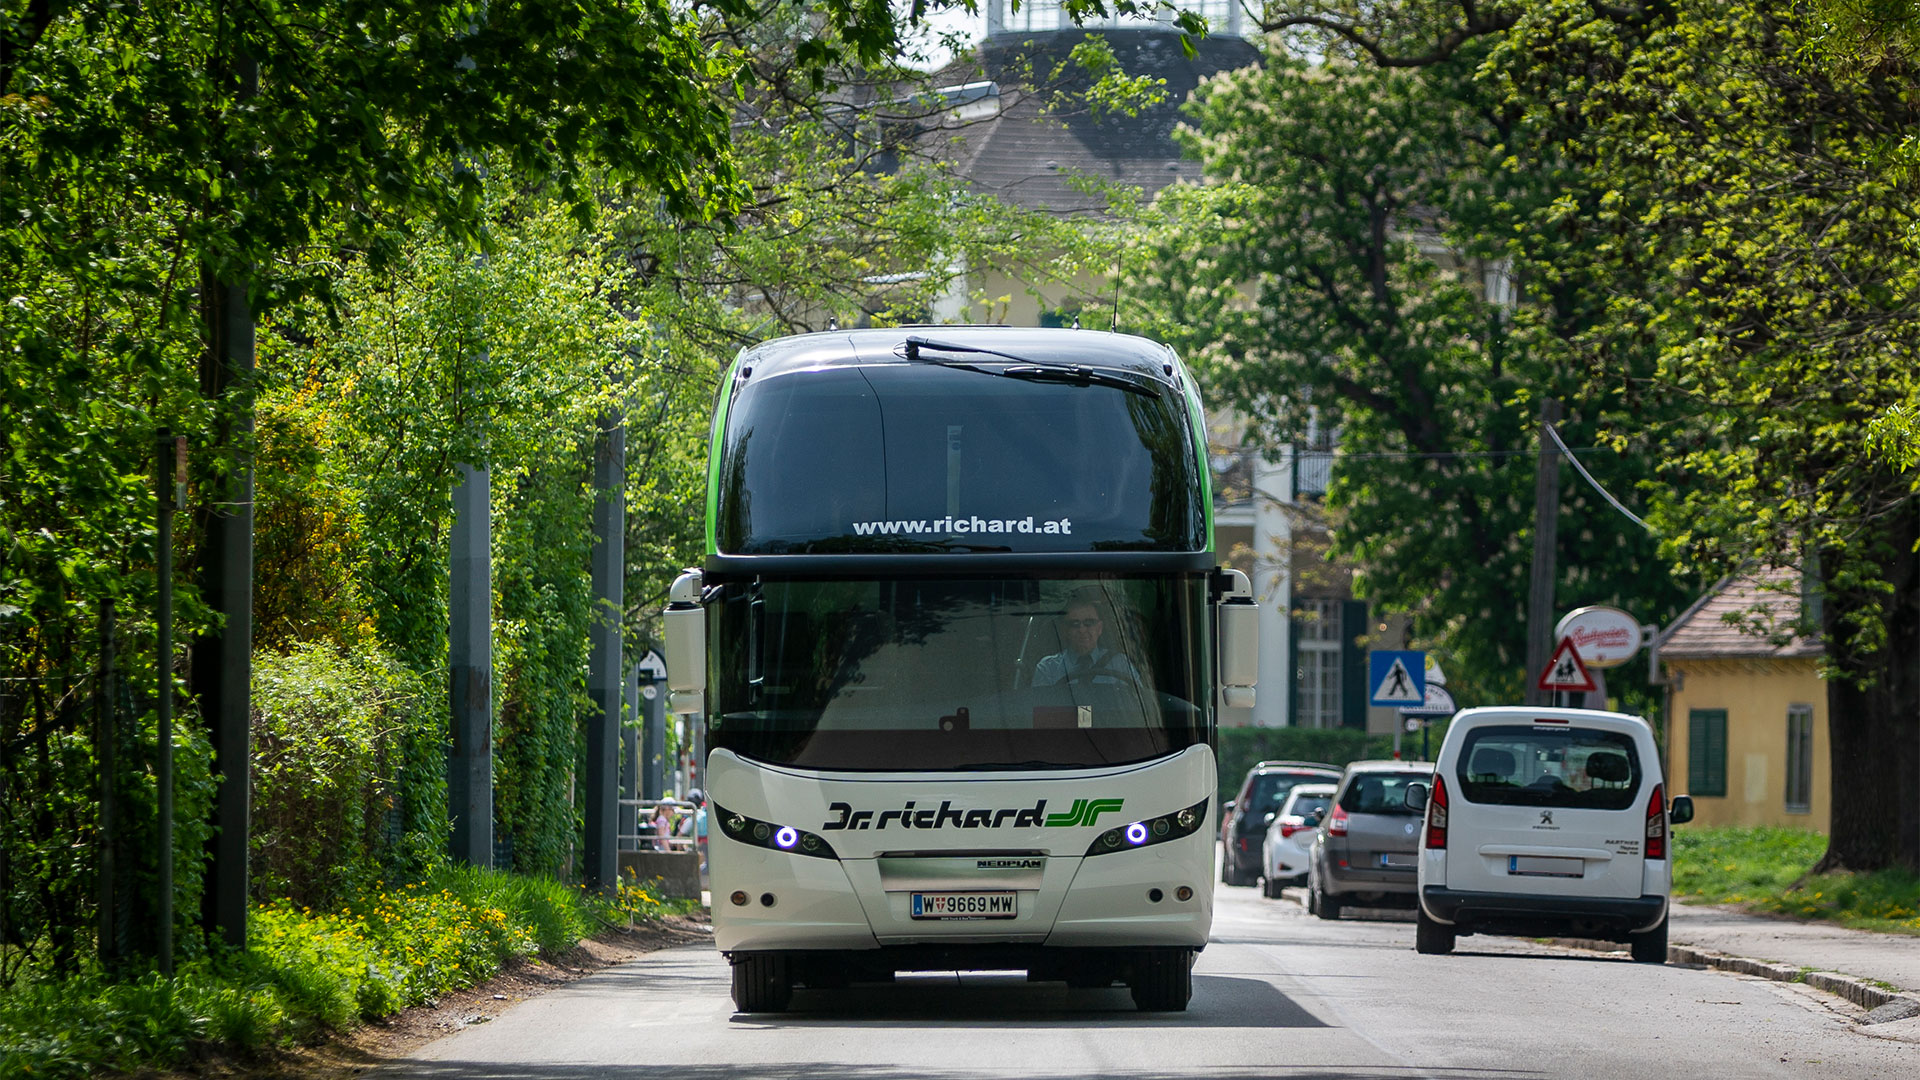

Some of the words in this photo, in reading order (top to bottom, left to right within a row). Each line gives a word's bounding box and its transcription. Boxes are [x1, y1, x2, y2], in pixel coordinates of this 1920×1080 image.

[853, 516, 1072, 535] www.richard.at
[822, 802, 874, 830] Dr.
[876, 800, 1048, 830] richard
[977, 860, 1041, 868] NEOPLAN
[923, 897, 935, 912] W
